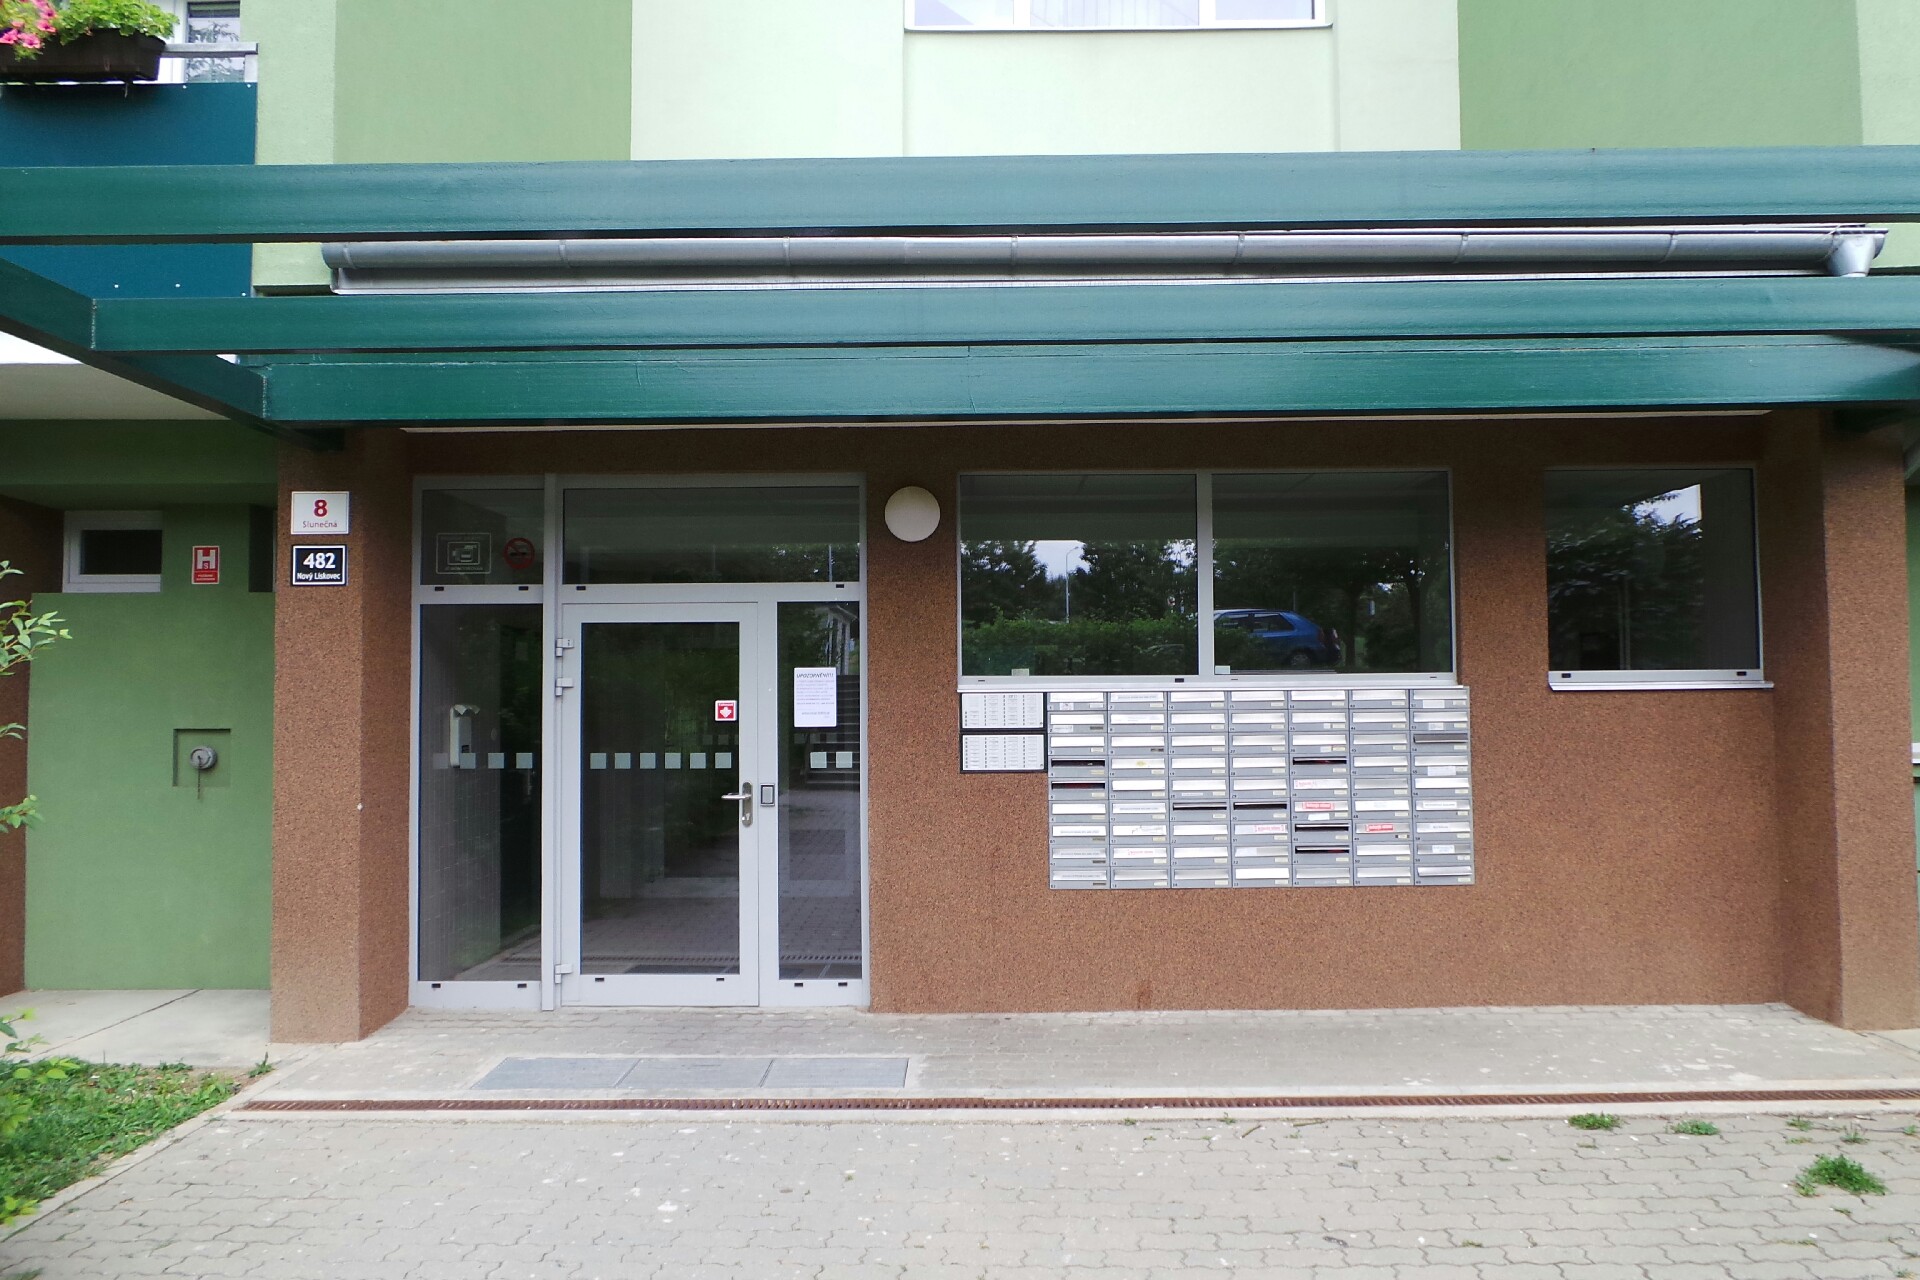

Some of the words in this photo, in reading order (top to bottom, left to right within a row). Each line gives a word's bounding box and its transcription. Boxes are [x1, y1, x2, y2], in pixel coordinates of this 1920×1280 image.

[313, 499, 328, 518] 8
[302, 520, 338, 528] Slunečná
[196, 549, 216, 570] H
[302, 552, 336, 569] 482
[296, 572, 314, 582] Nový
